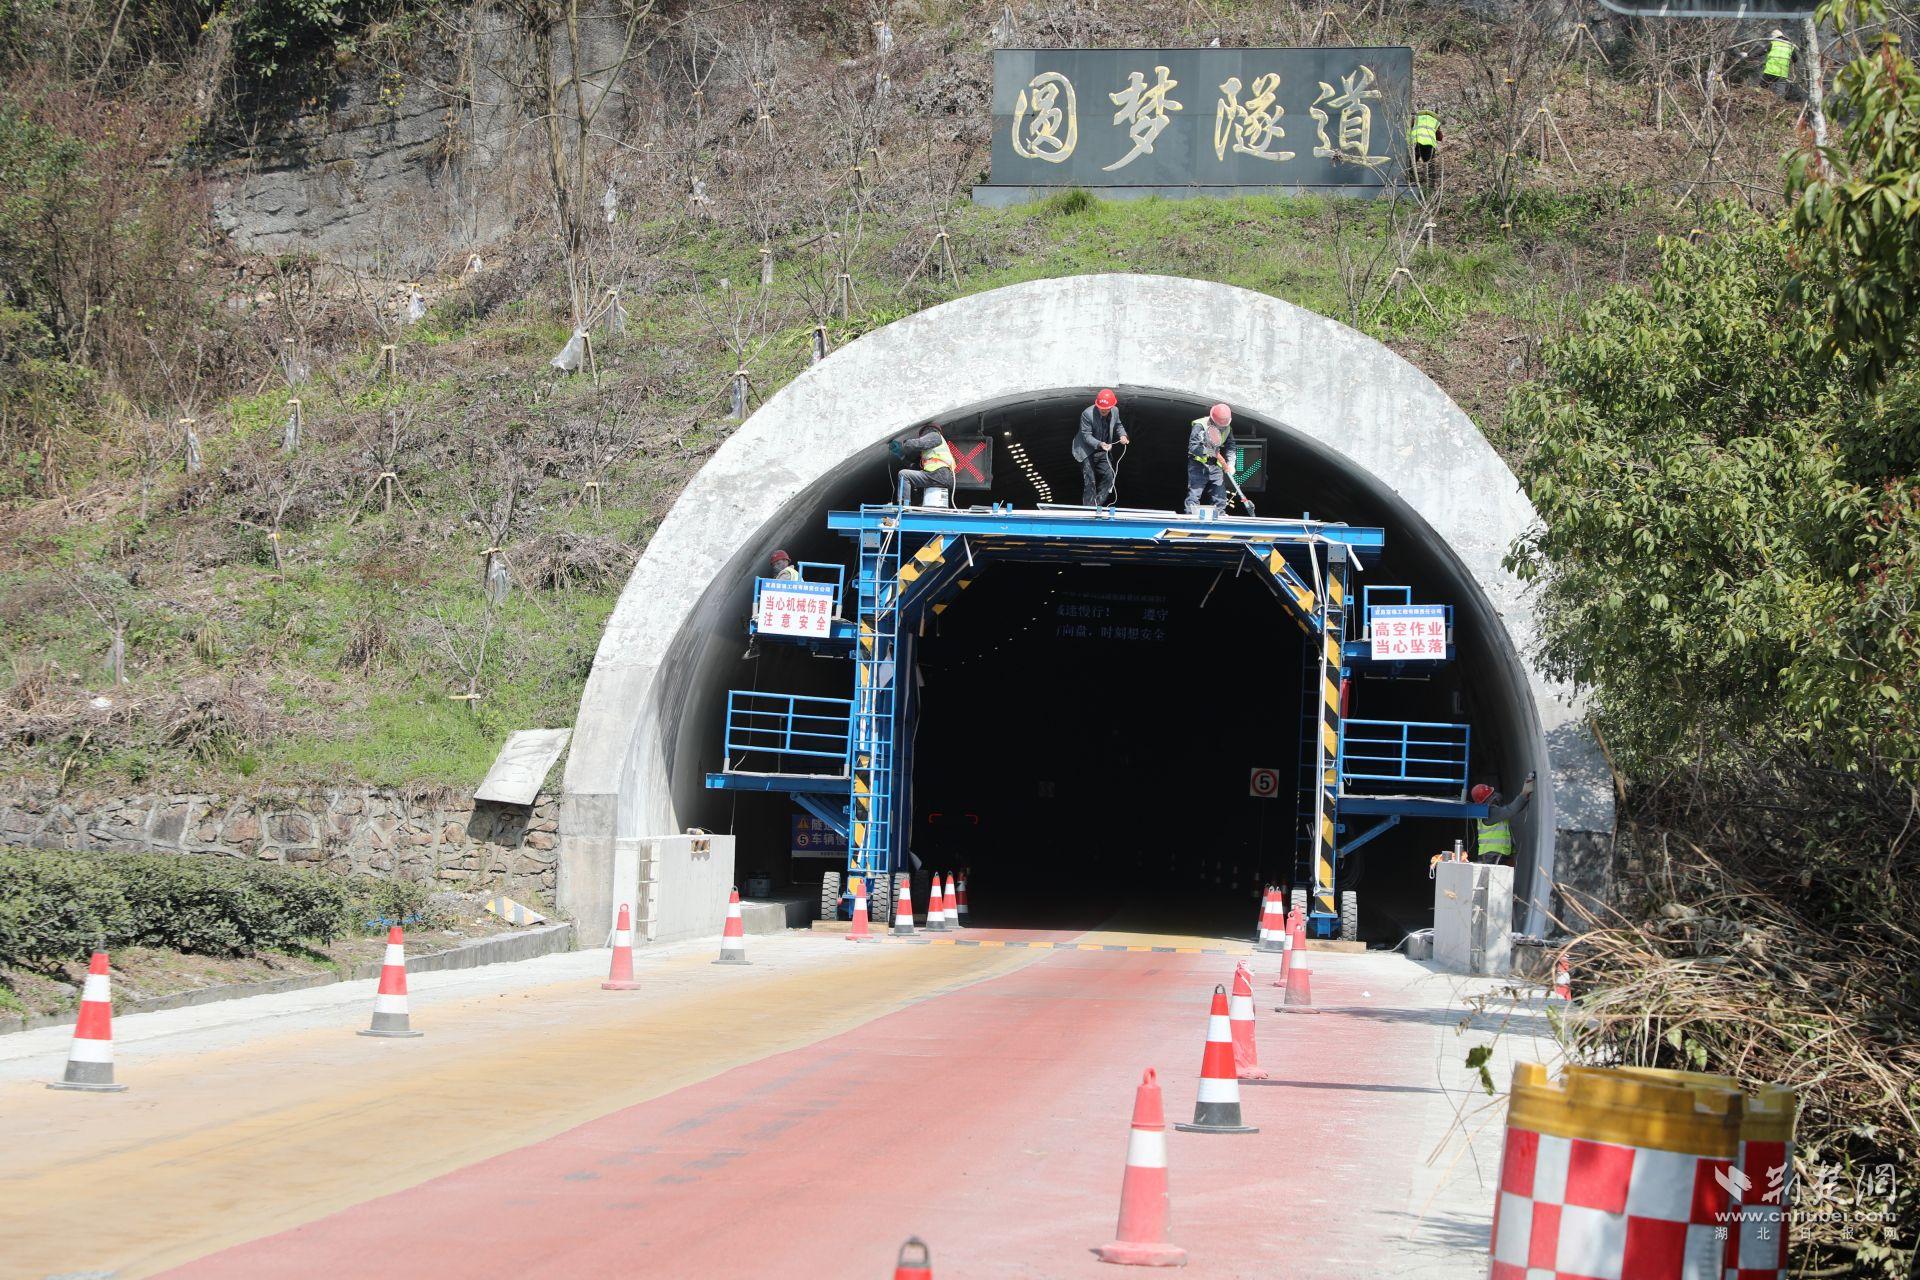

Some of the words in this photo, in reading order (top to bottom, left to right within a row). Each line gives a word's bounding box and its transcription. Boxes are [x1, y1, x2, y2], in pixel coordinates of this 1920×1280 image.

[1011, 65, 1391, 172] 圆梦隧道
[765, 595, 828, 615] 当心机械伤害
[764, 612, 826, 631] 注意安全
[1375, 621, 1443, 637] 高空作业
[1375, 639, 1443, 654] 当心坠落
[1259, 775, 1270, 790] 5
[799, 835, 807, 845] 5
